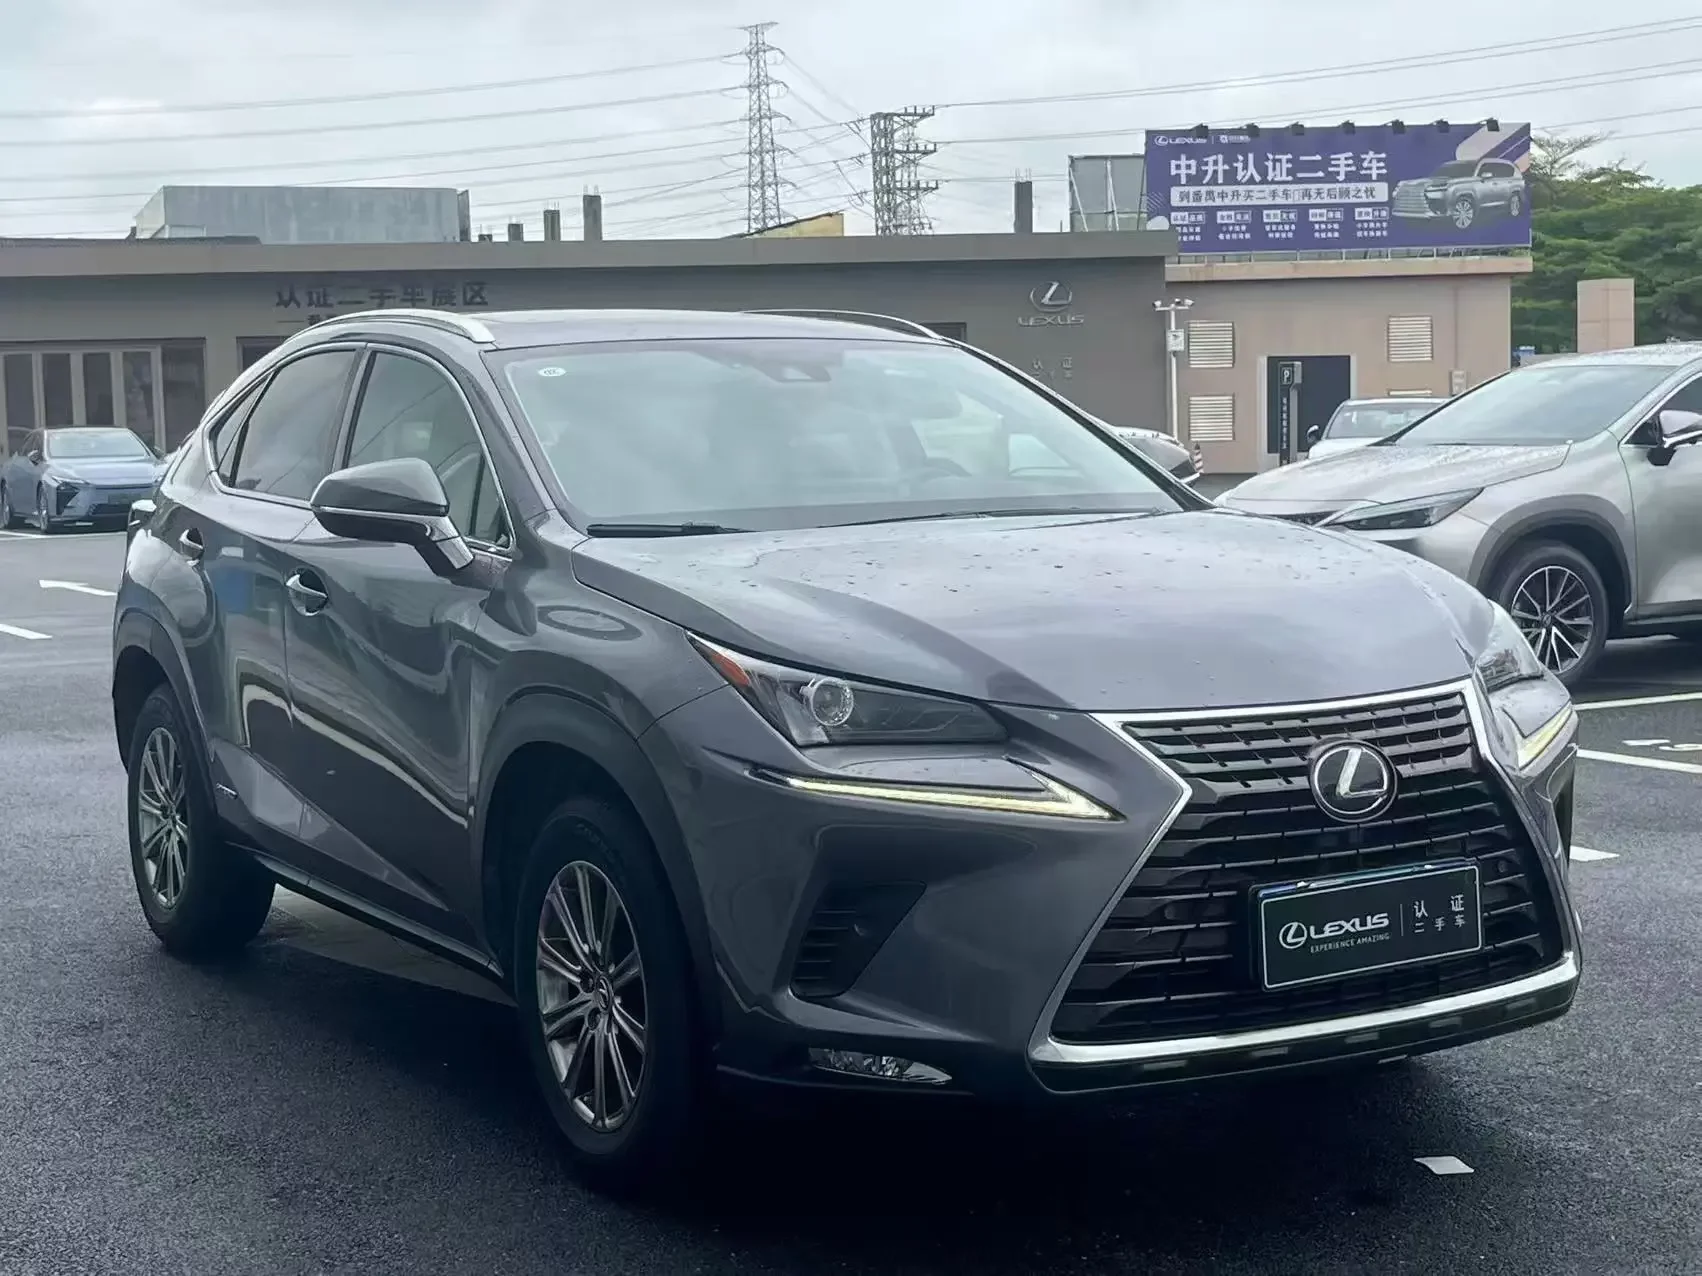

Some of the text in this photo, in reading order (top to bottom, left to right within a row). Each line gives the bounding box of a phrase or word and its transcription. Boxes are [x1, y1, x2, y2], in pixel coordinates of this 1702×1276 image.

[1169, 136, 1207, 144] LEXUS
[1170, 151, 1388, 184] 中升认证二手车
[1017, 314, 1084, 327] LEXUS
[1310, 913, 1390, 940] LEXUS
[1414, 914, 1466, 934] 二手车
[1310, 932, 1391, 954] EXPERIENCE AMAZING
